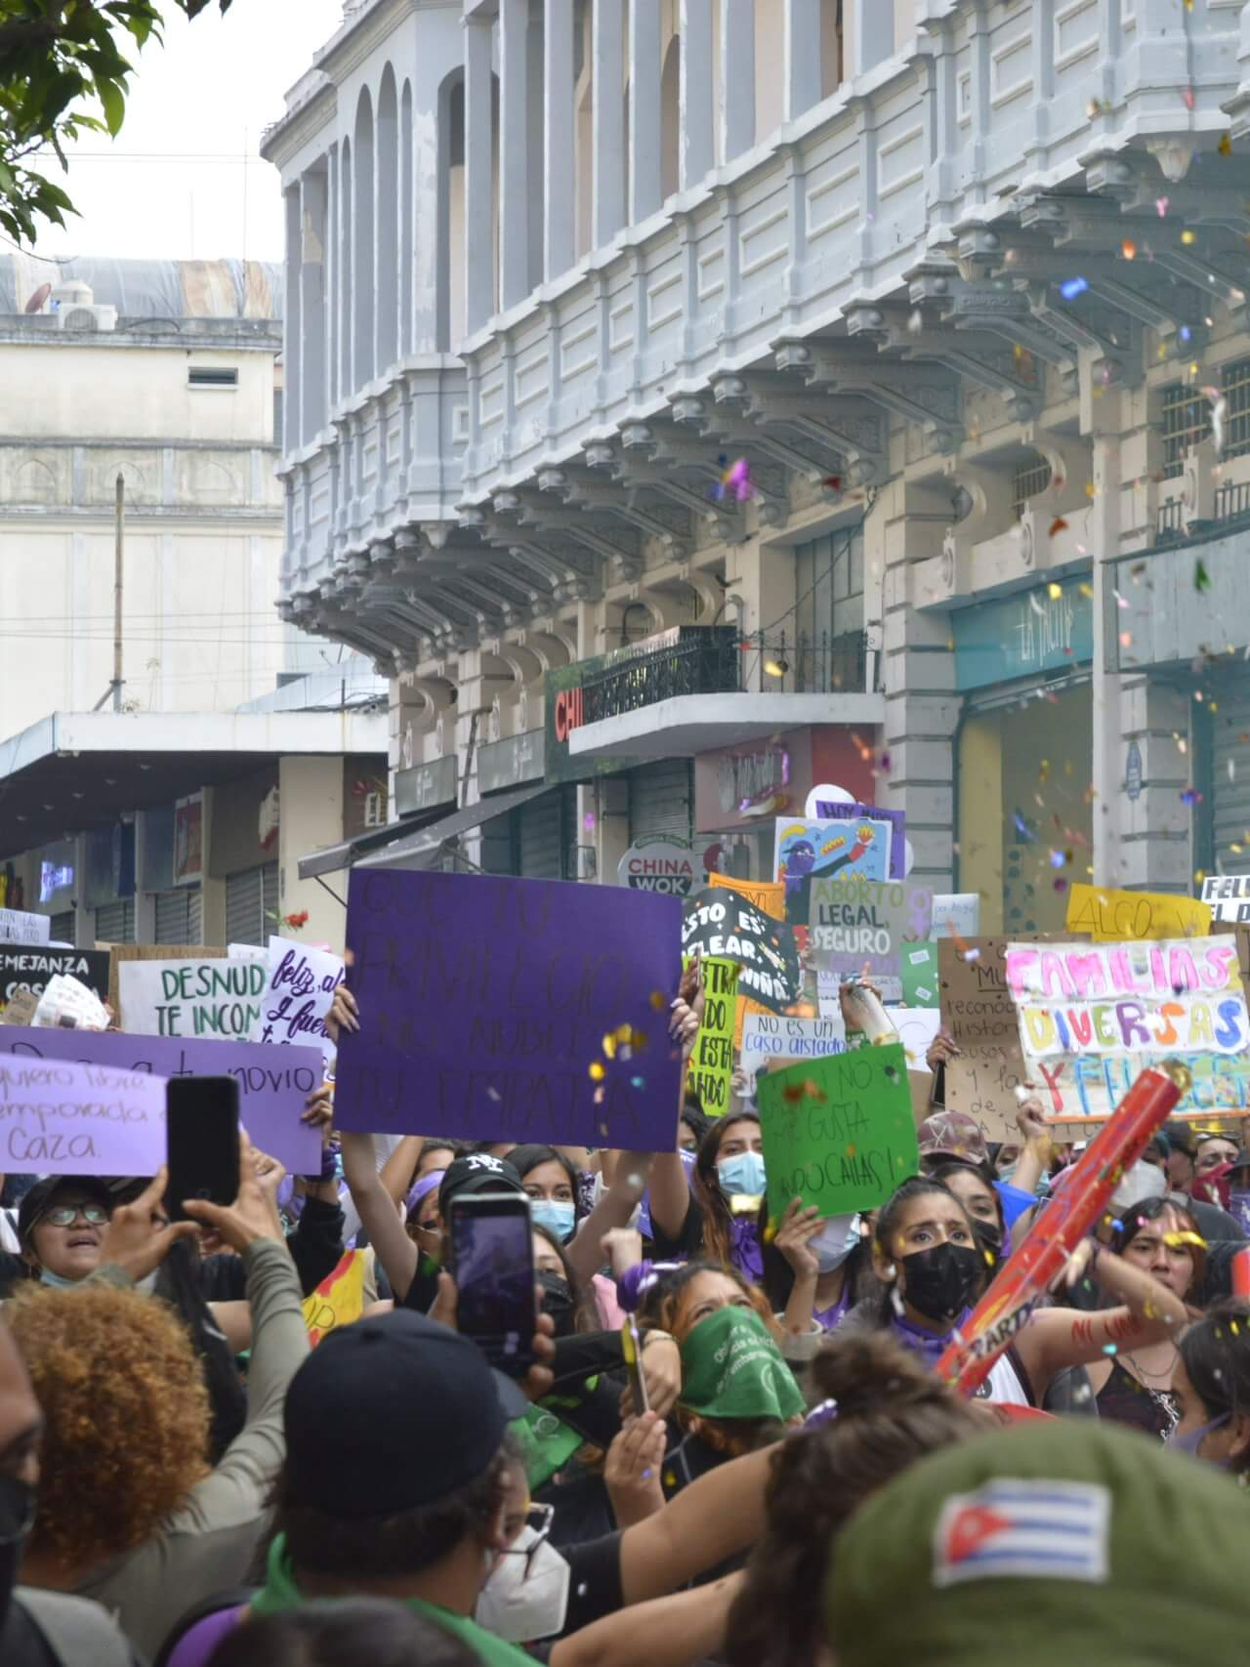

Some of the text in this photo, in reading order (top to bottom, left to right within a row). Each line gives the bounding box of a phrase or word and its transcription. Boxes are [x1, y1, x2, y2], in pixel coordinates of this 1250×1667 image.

[628, 858, 693, 875] CHINA
[635, 877, 686, 895] WOK
[815, 881, 906, 907] ABORTO
[813, 928, 891, 955] SEGURO
[1007, 947, 1233, 997] FAMILIAS
[156, 1005, 182, 1037] TE
[1024, 999, 1242, 1049] DIVERSAS
[228, 1066, 315, 1095] novio
[1038, 1062, 1066, 1113] Y
